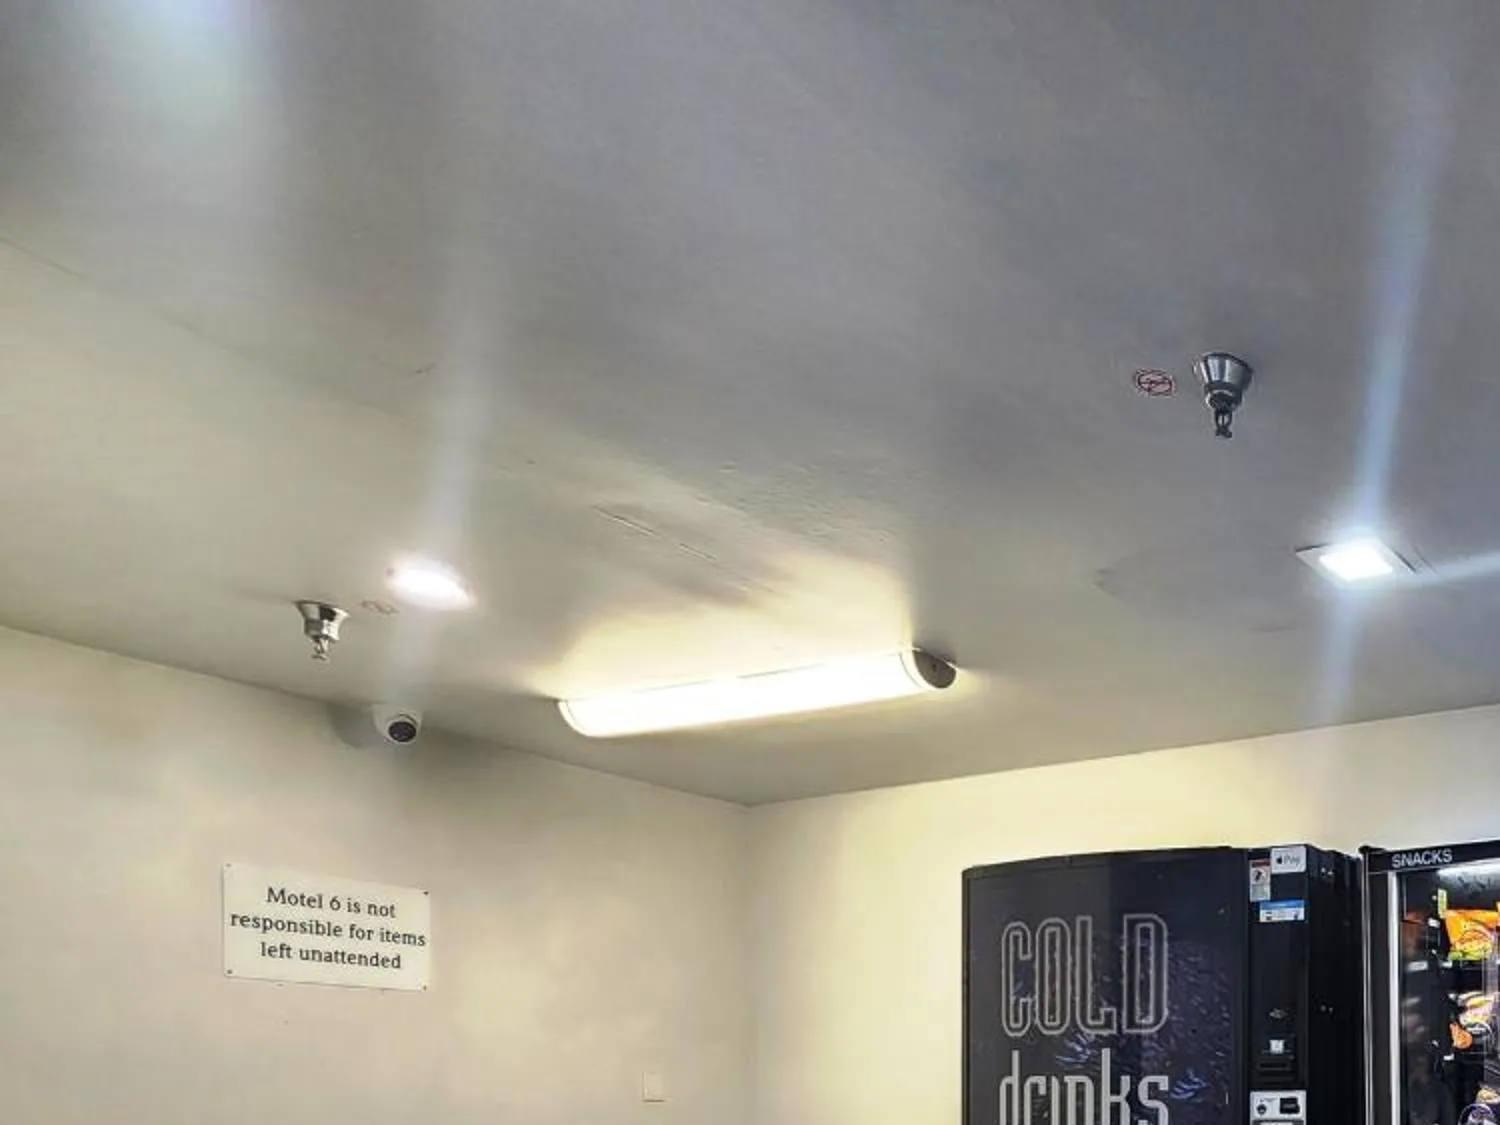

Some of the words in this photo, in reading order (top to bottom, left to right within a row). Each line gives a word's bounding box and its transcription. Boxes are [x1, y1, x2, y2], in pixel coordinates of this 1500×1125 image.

[1392, 849, 1452, 869] SNACKS
[267, 887, 323, 909] Motel
[329, 896, 341, 911] 6
[347, 898, 361, 913] is
[367, 902, 396, 918] not
[231, 913, 343, 936] responsible
[349, 924, 374, 941] for
[380, 928, 426, 947] items
[261, 942, 292, 959] left
[299, 947, 401, 969] unattended
[1002, 913, 1169, 1036] COLD
